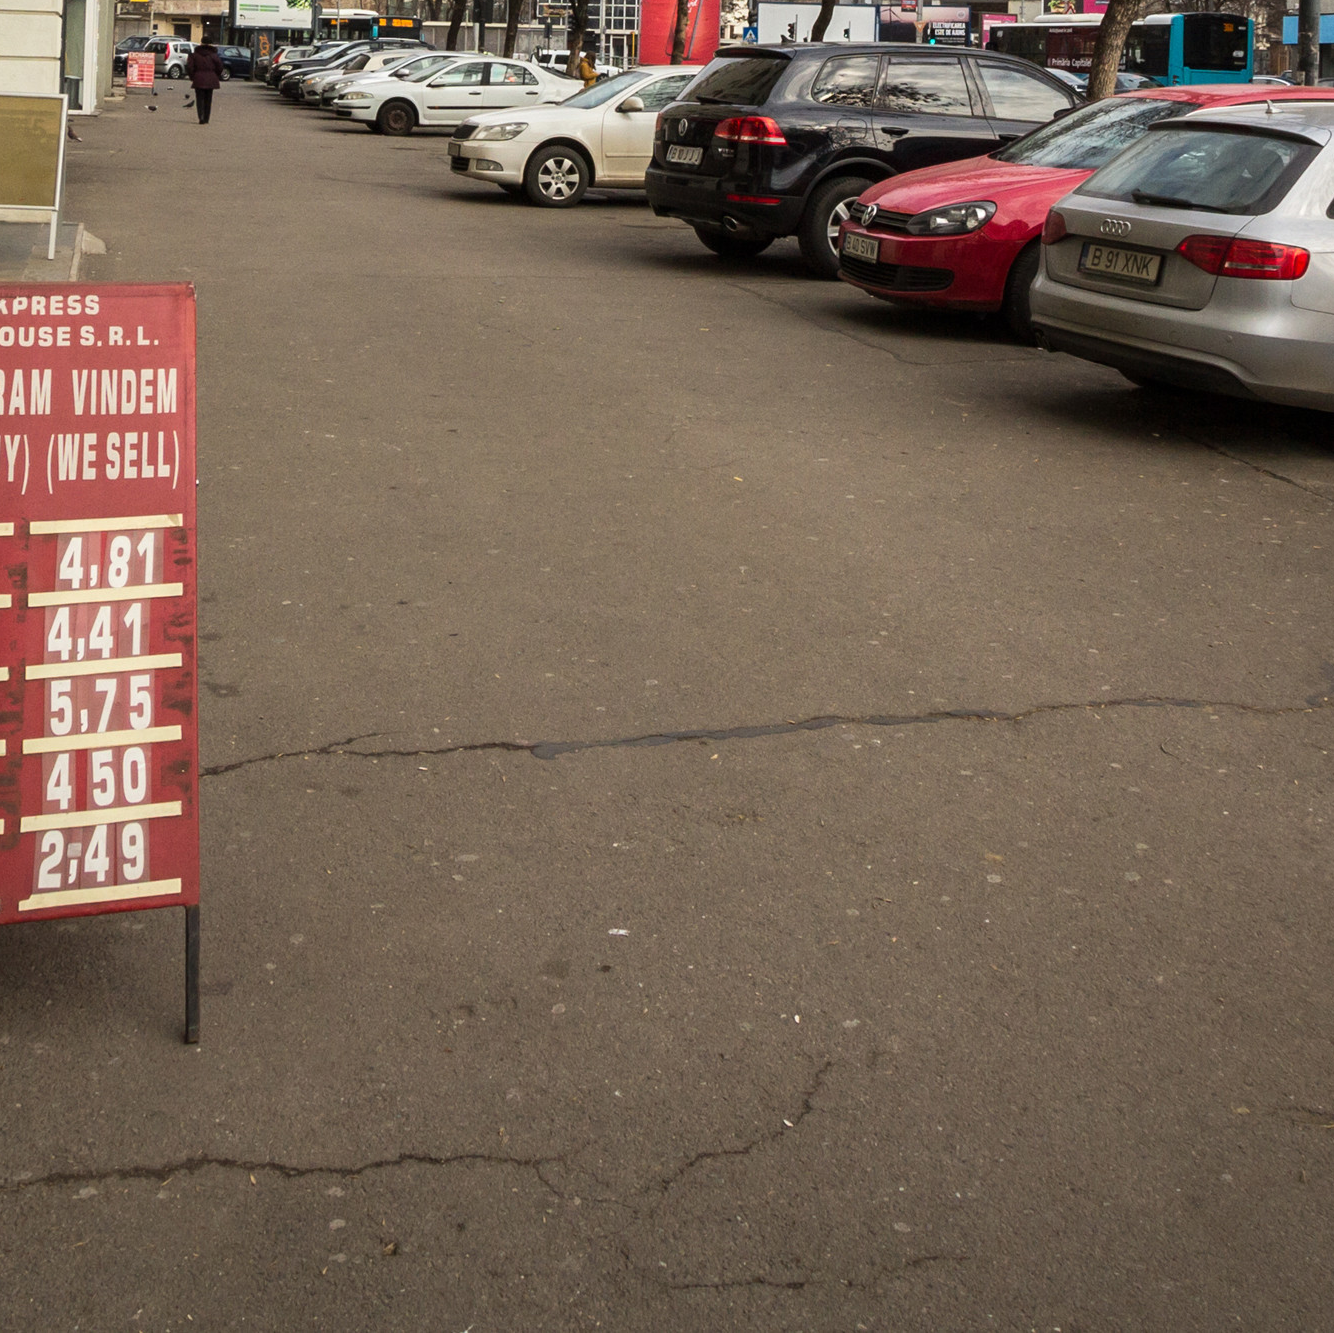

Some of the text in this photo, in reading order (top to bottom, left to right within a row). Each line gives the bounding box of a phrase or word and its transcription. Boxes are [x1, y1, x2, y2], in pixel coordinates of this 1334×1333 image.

[1091, 247, 1154, 276] B 91 XNK
[71, 368, 178, 416] VINDEM
[47, 433, 96, 494] (WE
[105, 429, 181, 488] SELL)
[58, 531, 156, 590] 4,81
[47, 602, 143, 661] 4,41
[50, 675, 152, 736] 5,75
